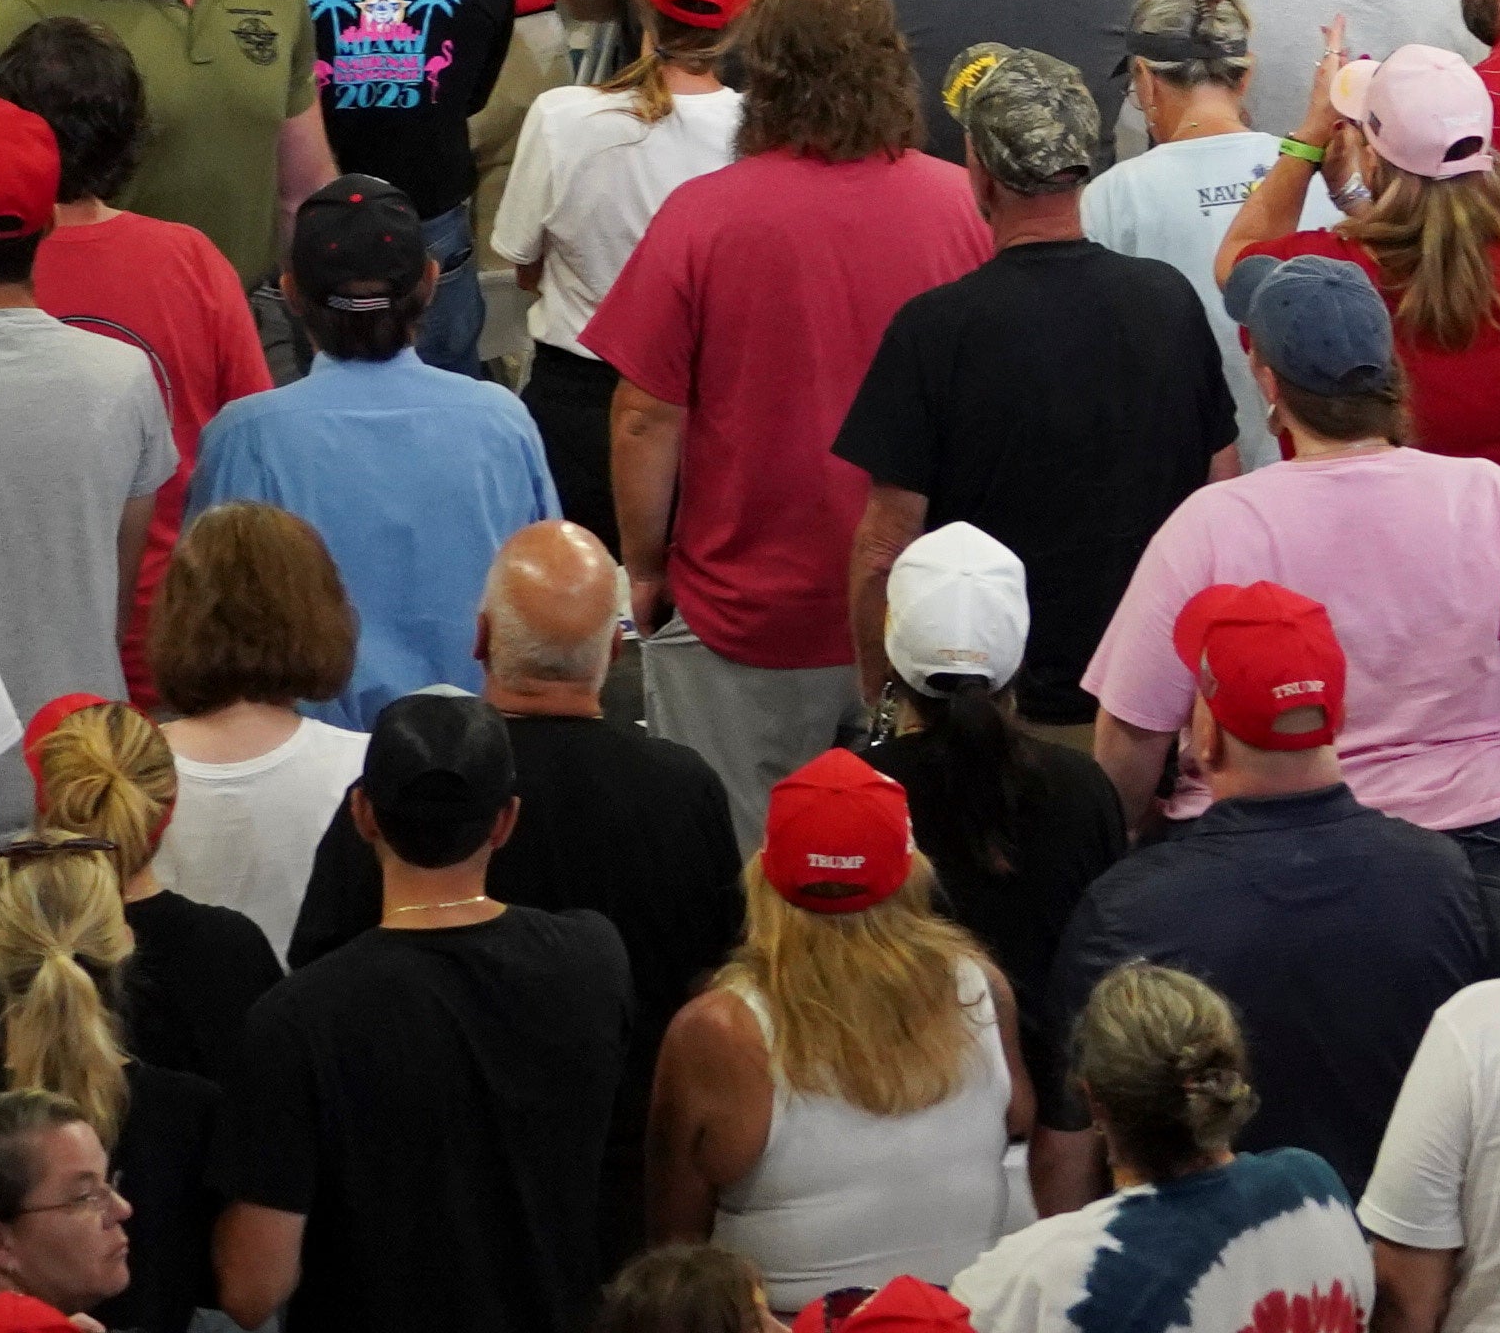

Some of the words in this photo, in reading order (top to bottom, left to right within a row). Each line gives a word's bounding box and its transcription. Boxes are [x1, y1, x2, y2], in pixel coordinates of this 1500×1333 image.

[338, 37, 421, 55] MIAMI
[336, 83, 421, 109] 2025
[1197, 180, 1253, 204] NAVY
[1272, 680, 1325, 699] TRUMP
[808, 854, 865, 869] TRUMP
